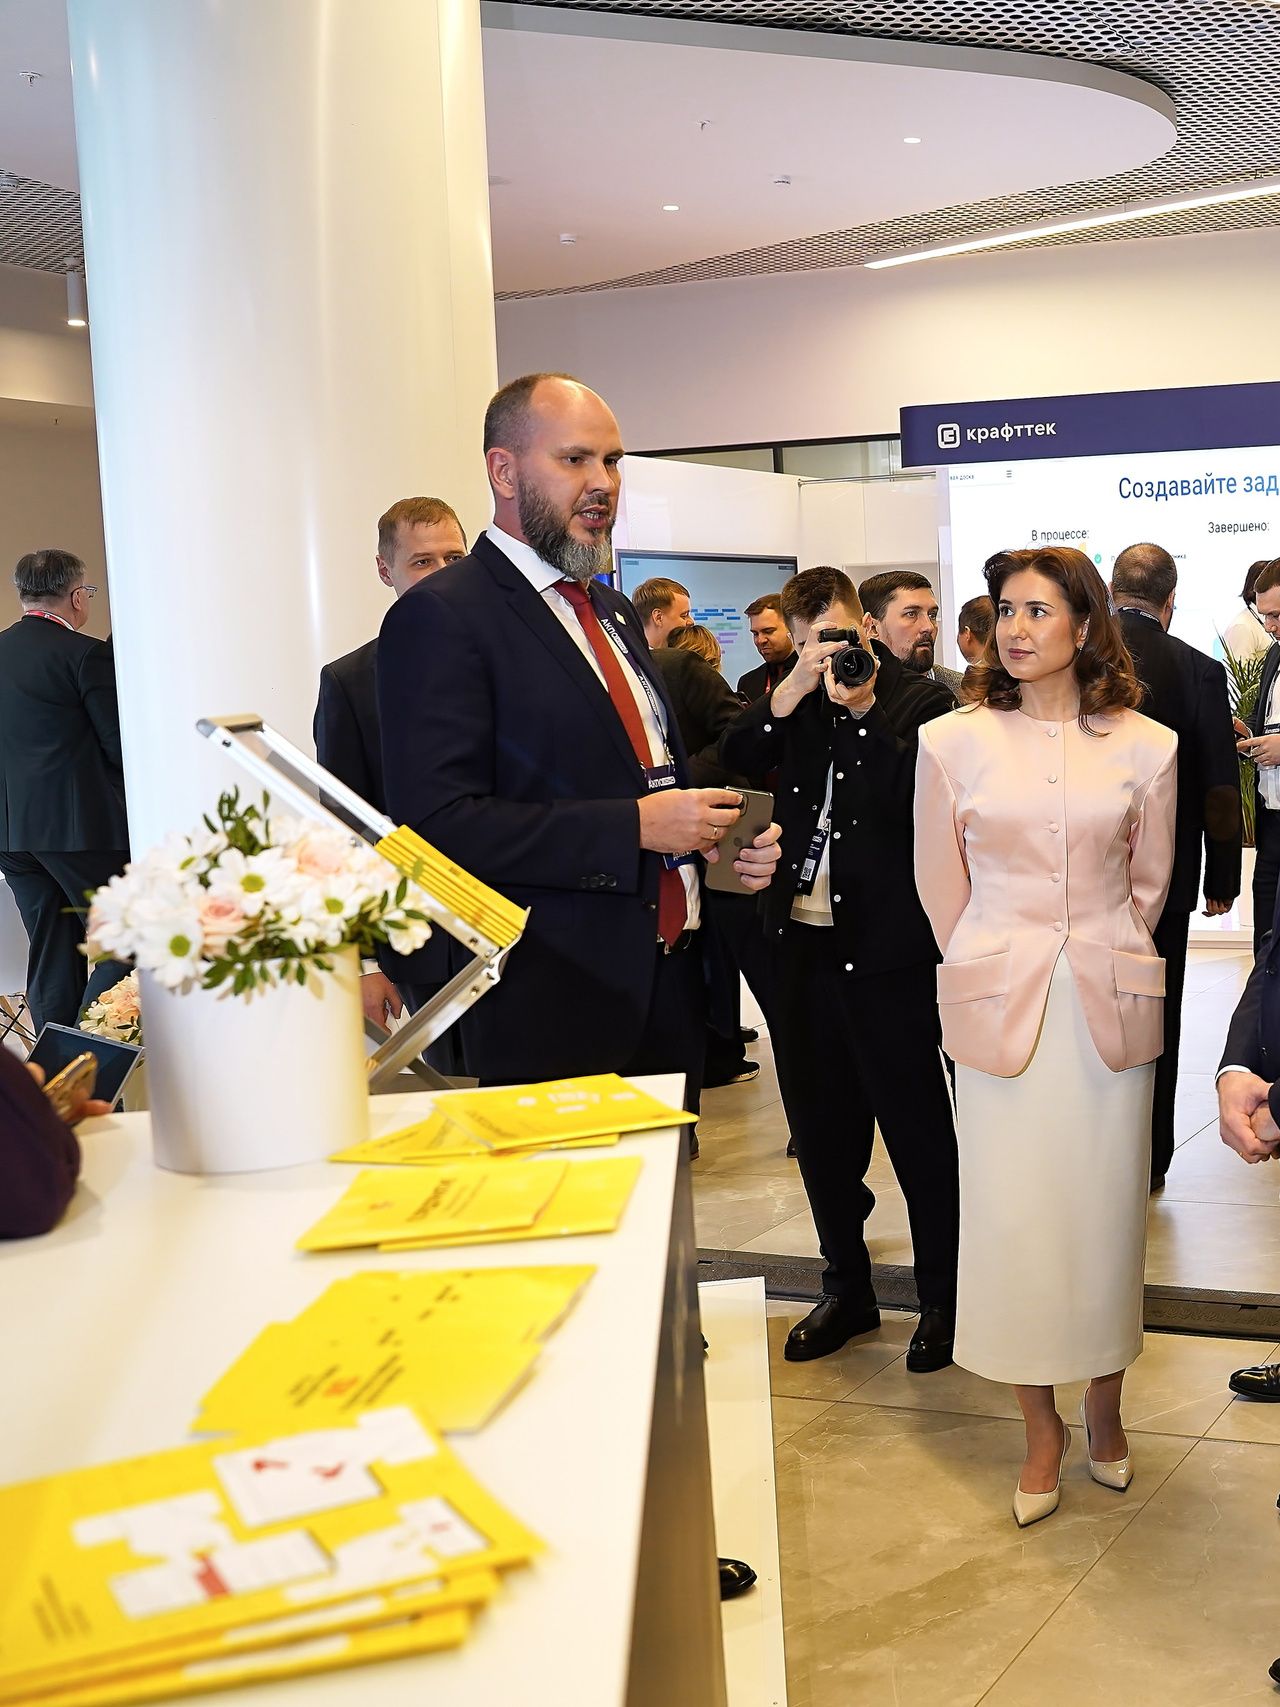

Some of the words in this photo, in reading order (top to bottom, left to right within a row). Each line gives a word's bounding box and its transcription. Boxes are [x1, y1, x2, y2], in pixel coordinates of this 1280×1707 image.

[966, 422, 1057, 444] крафттек
[1118, 472, 1238, 502] Создавайте
[1031, 529, 1038, 542] В
[1040, 528, 1090, 543] процессе:
[1207, 521, 1270, 535] Завершено:
